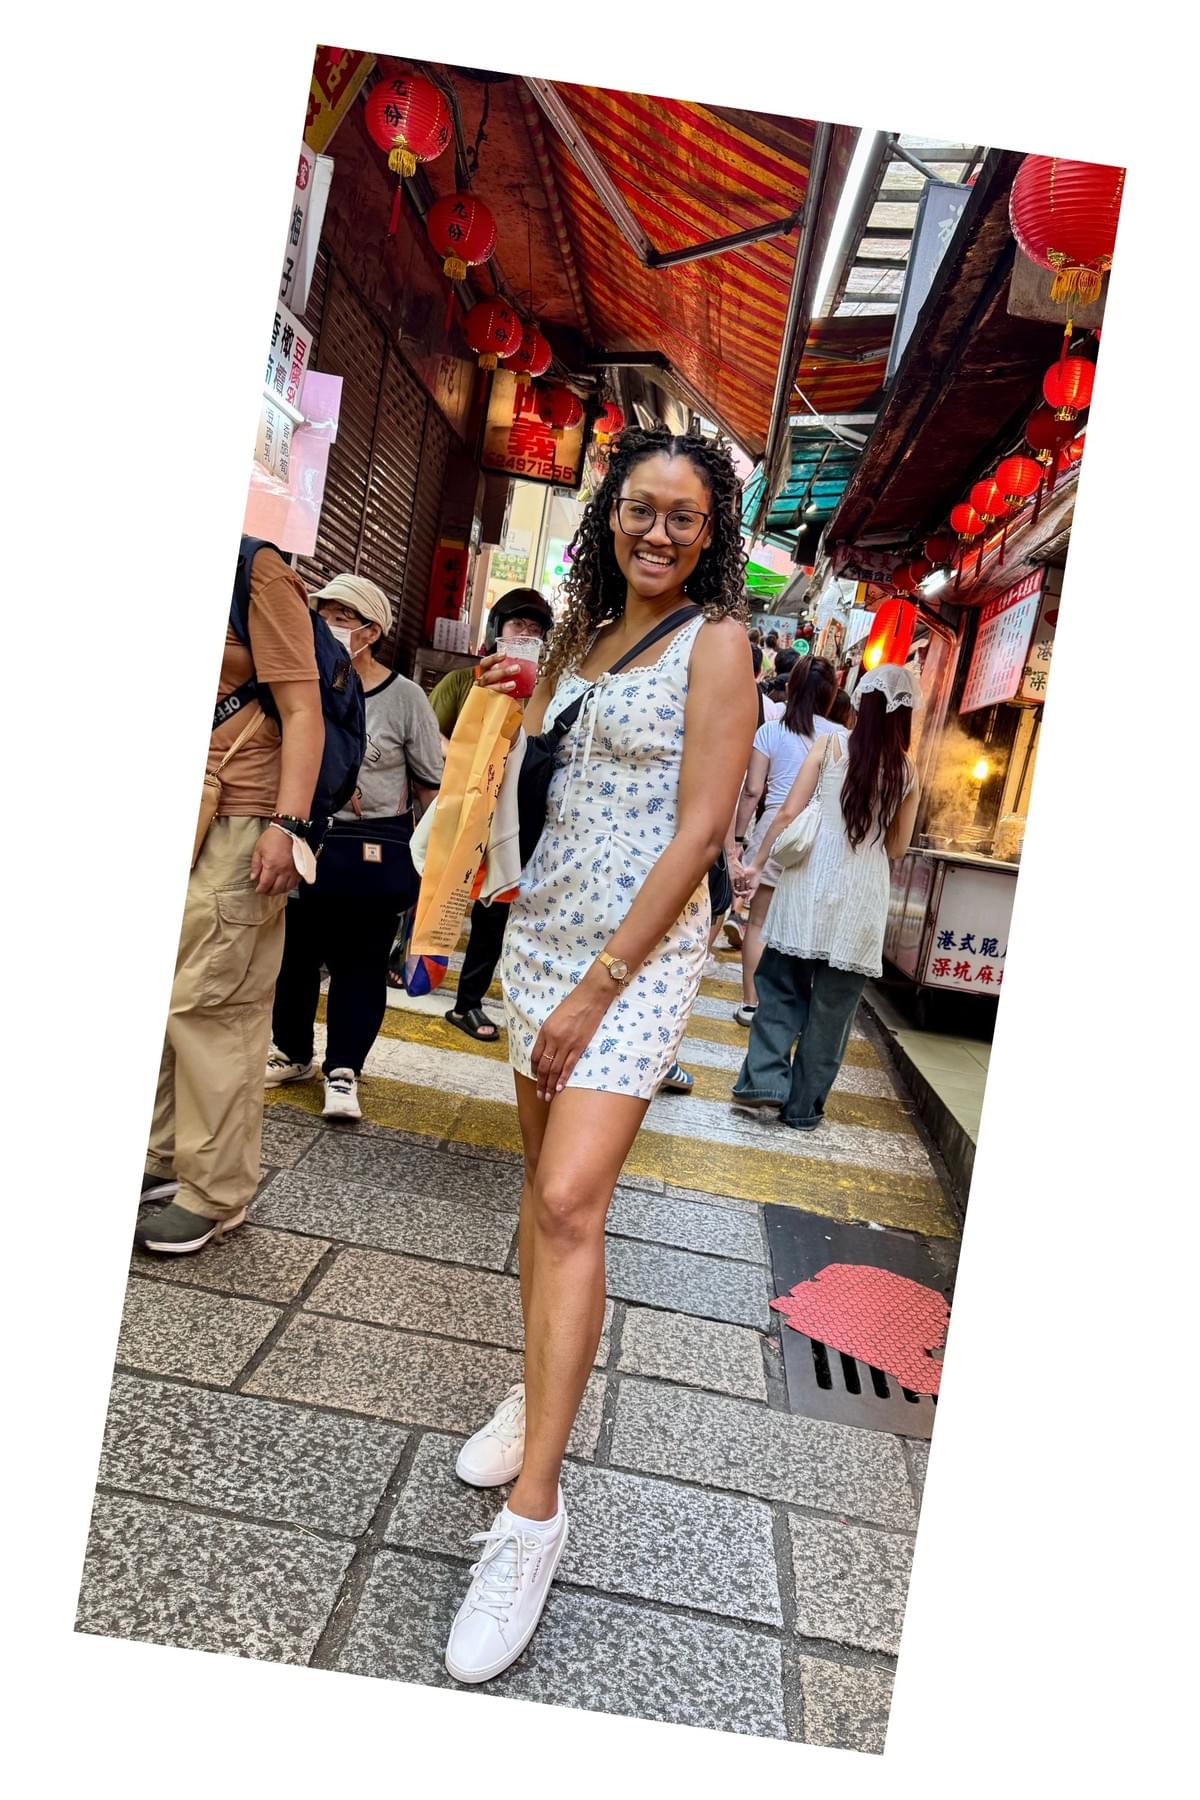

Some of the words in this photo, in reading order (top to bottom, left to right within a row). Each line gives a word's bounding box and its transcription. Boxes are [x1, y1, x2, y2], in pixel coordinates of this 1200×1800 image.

[384, 79, 407, 128] 九份
[449, 202, 467, 242] 九份
[213, 696, 241, 721] OFF
[936, 930, 1007, 958] 港式脆
